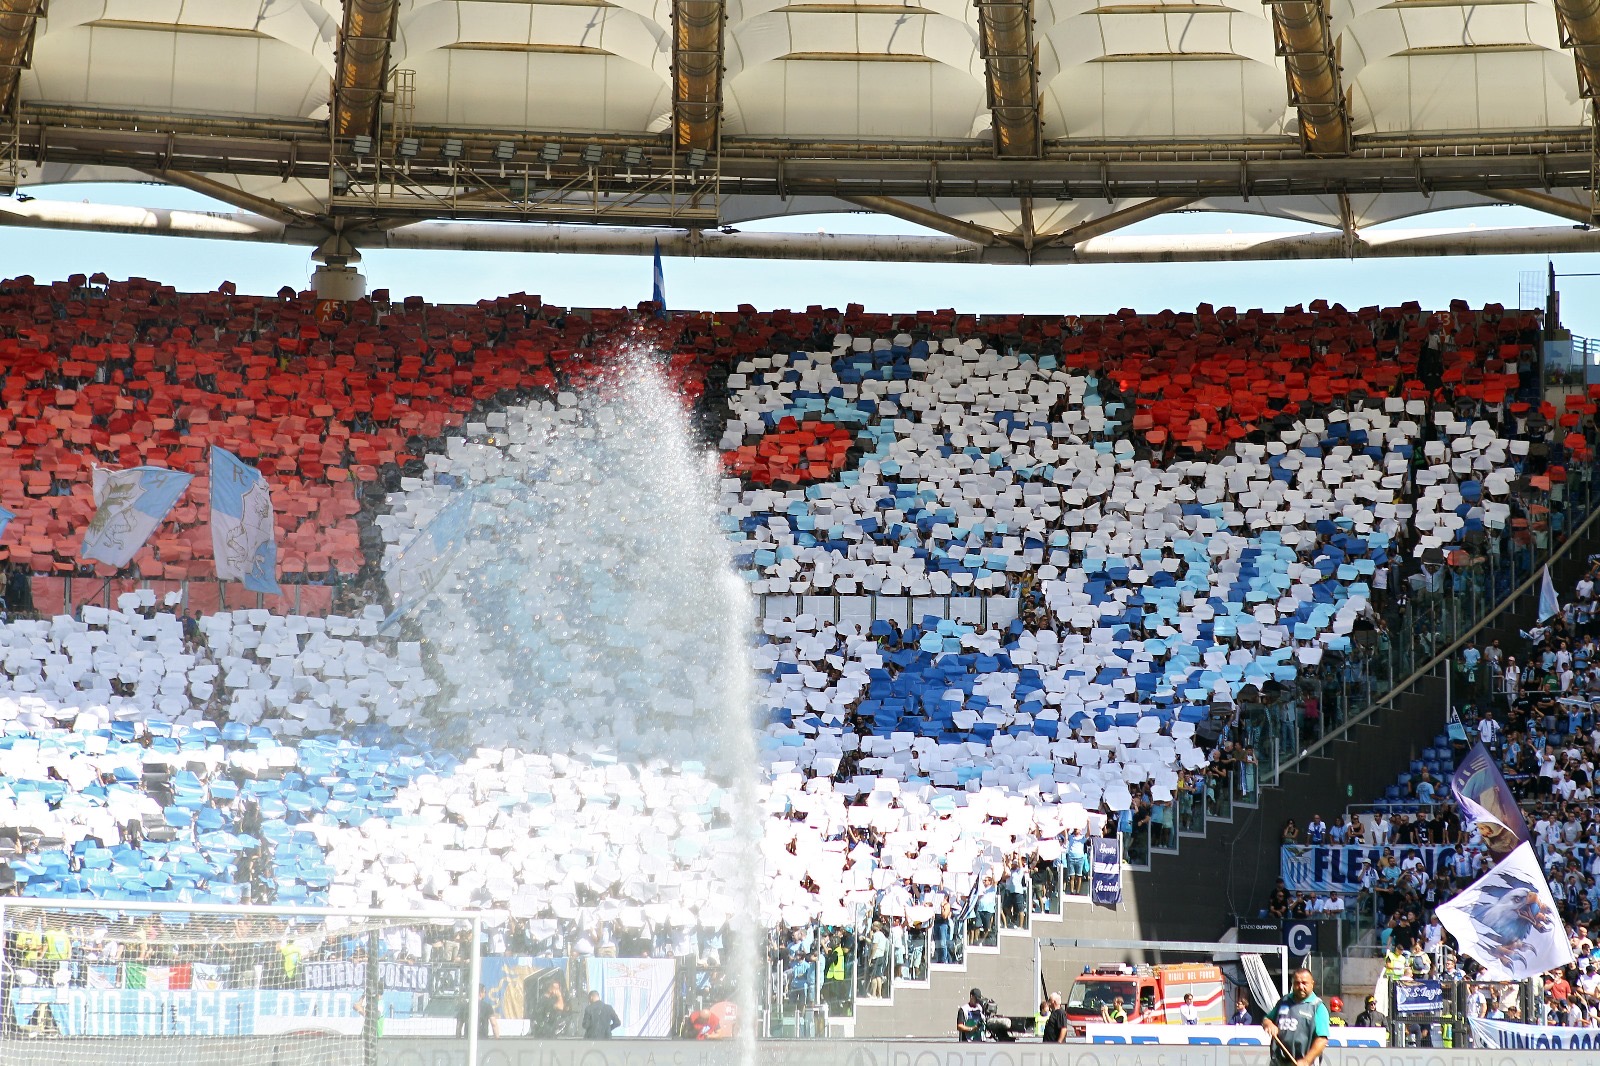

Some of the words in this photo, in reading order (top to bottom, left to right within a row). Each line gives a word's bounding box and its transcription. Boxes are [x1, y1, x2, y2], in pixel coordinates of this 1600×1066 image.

[1288, 924, 1312, 956] C
[305, 962, 364, 989] FOLIGNO
[1187, 971, 1197, 980] DEL
